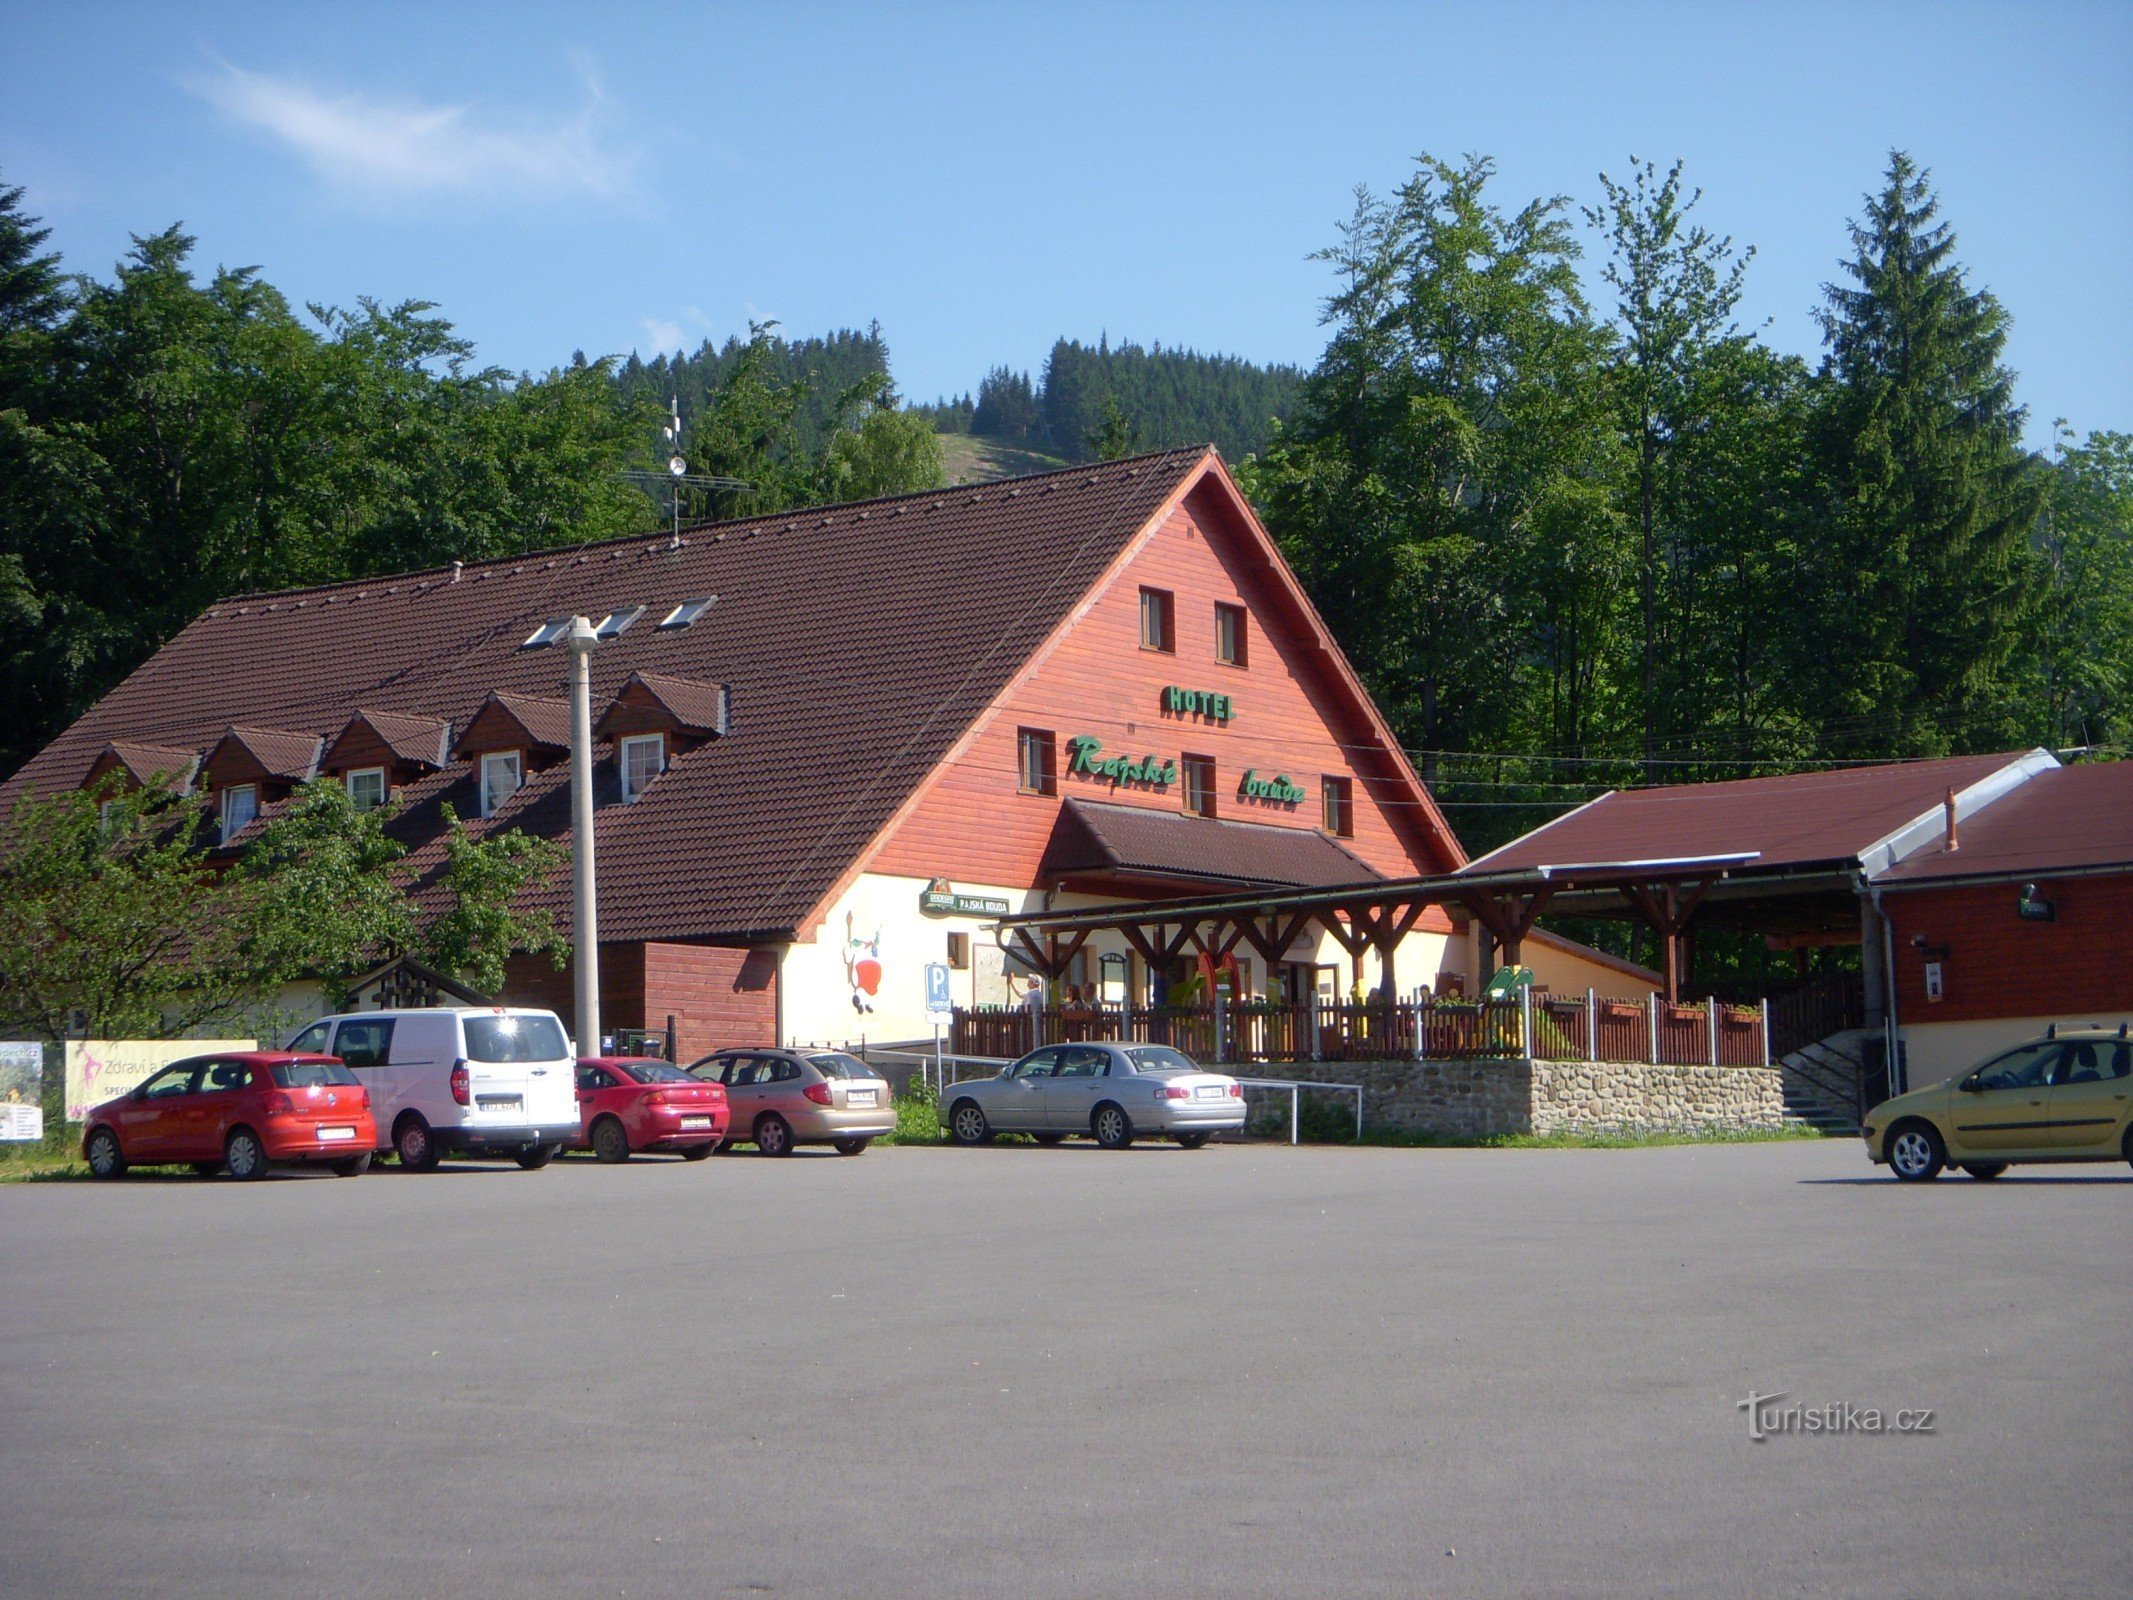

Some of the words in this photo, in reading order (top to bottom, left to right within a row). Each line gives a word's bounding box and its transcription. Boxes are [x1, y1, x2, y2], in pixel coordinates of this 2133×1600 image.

[1169, 685, 1238, 720] HOTEL
[1074, 735, 1178, 788] Rajská
[1245, 767, 1306, 803] bouda
[959, 898, 985, 911] RAJSKÁ
[985, 901, 1008, 913] BOUDA
[932, 967, 946, 996] P
